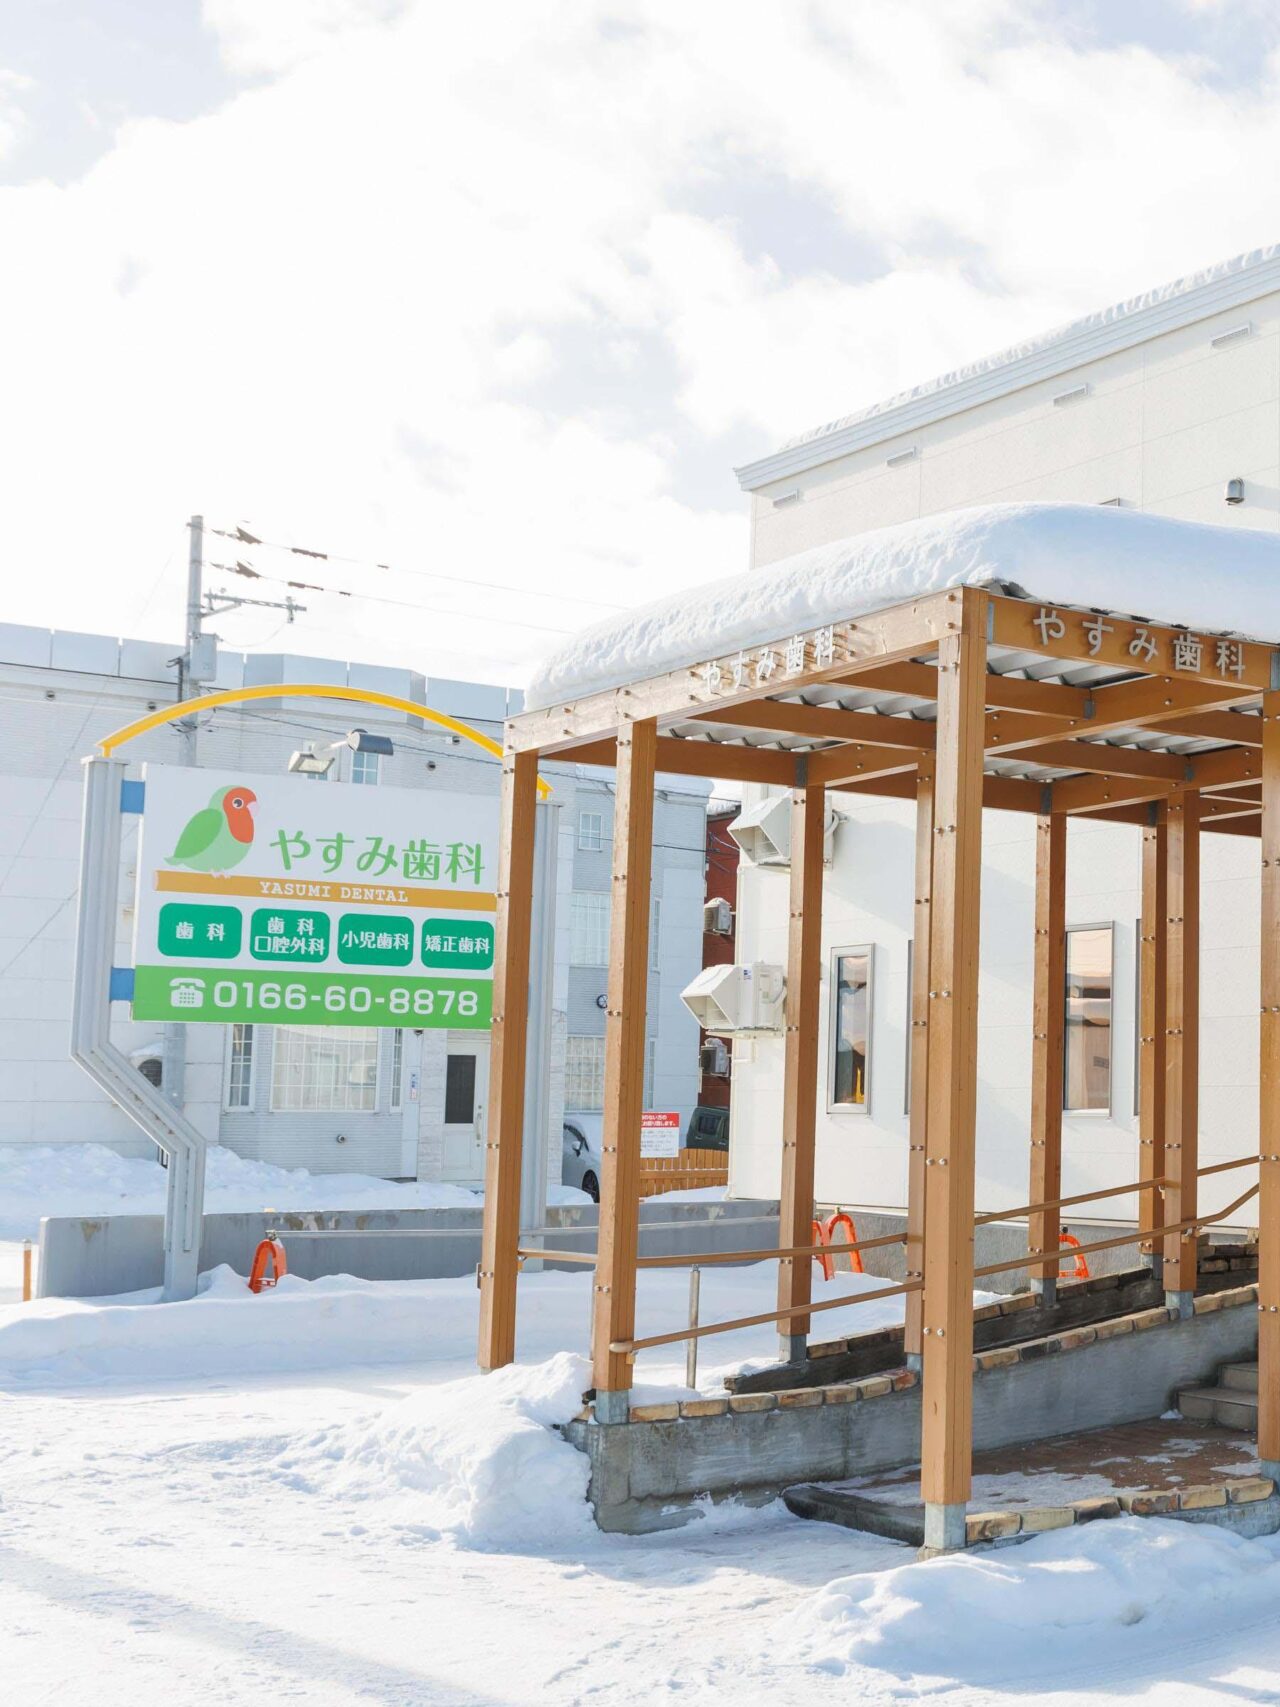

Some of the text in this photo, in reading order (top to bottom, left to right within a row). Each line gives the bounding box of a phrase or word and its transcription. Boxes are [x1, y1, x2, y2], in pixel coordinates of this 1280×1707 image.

[1033, 607, 1246, 680] やすみ歯科
[702, 624, 835, 694] やすみ歯科
[269, 829, 486, 885] やすみ歯科
[259, 881, 408, 902] YASUMI DENTAL
[254, 936, 325, 956] 口腔外科
[341, 930, 410, 951] 小児歯科
[425, 934, 491, 955] 矯正歯科
[213, 980, 479, 1017] 0166-60-8878
